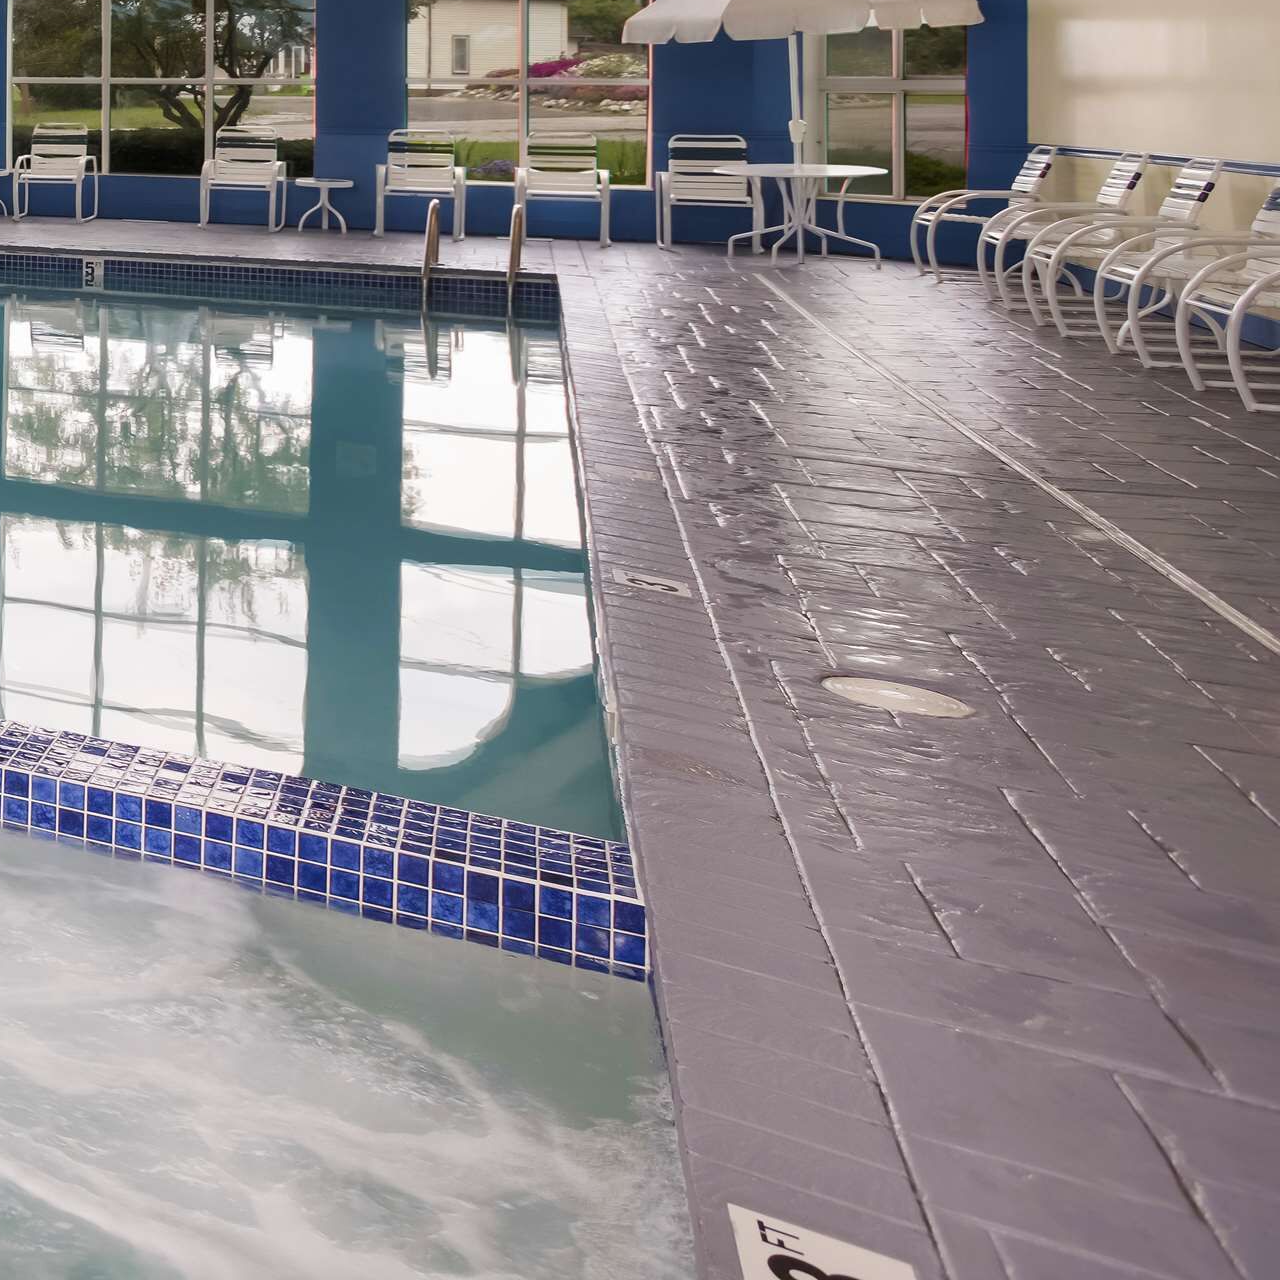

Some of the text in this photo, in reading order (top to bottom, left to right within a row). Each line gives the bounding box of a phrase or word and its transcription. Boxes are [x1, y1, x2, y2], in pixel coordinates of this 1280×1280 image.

[85, 261, 95, 275] 5
[625, 577, 679, 592] 3
[756, 1219, 804, 1256] FT
